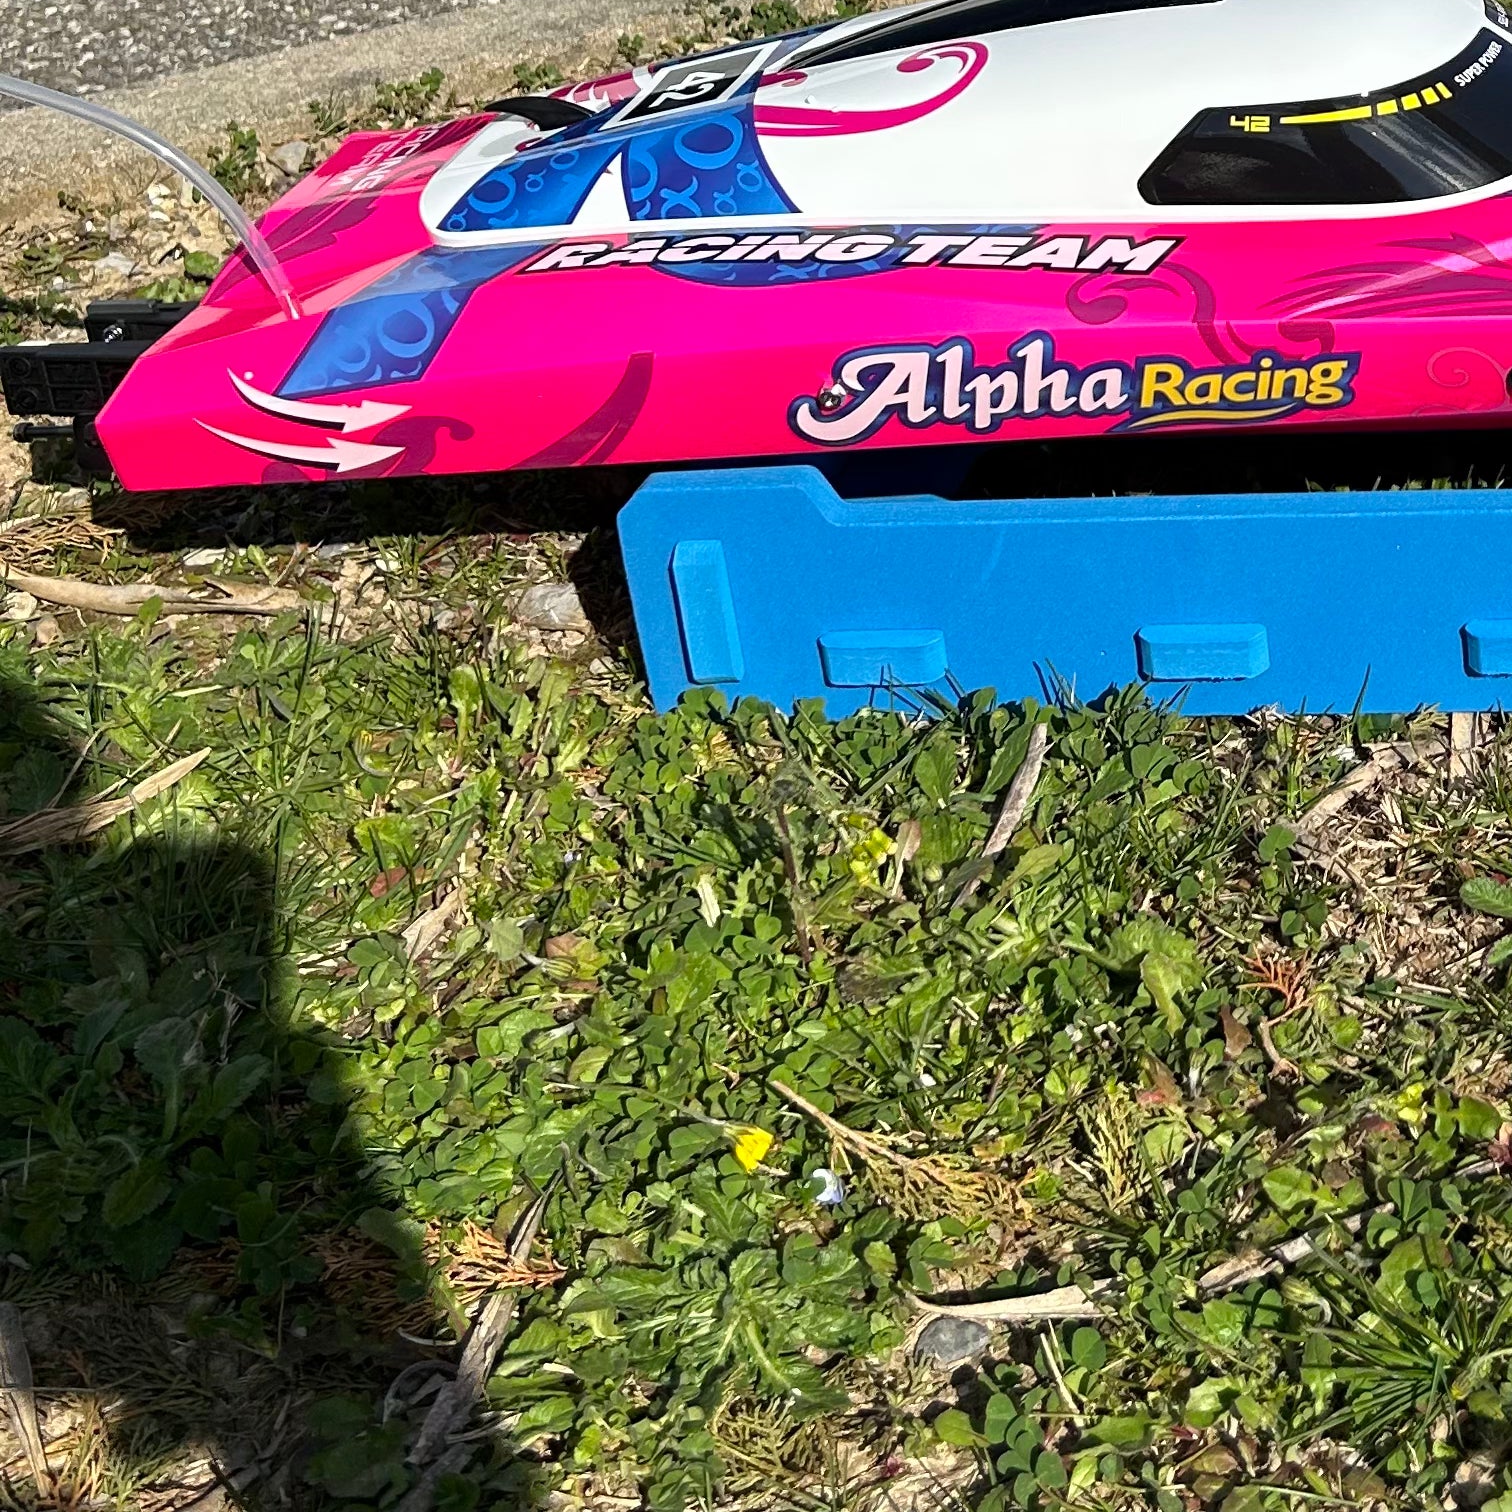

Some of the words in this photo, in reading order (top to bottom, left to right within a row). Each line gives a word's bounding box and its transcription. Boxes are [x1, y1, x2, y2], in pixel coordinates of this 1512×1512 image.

[648, 71, 726, 108] 42
[1454, 62, 1486, 87] SUPER
[1230, 115, 1270, 133] 42
[525, 235, 885, 270] RACING
[901, 235, 1183, 272] TEAM
[797, 339, 1129, 441] Alpha
[1140, 357, 1349, 408] Racing
